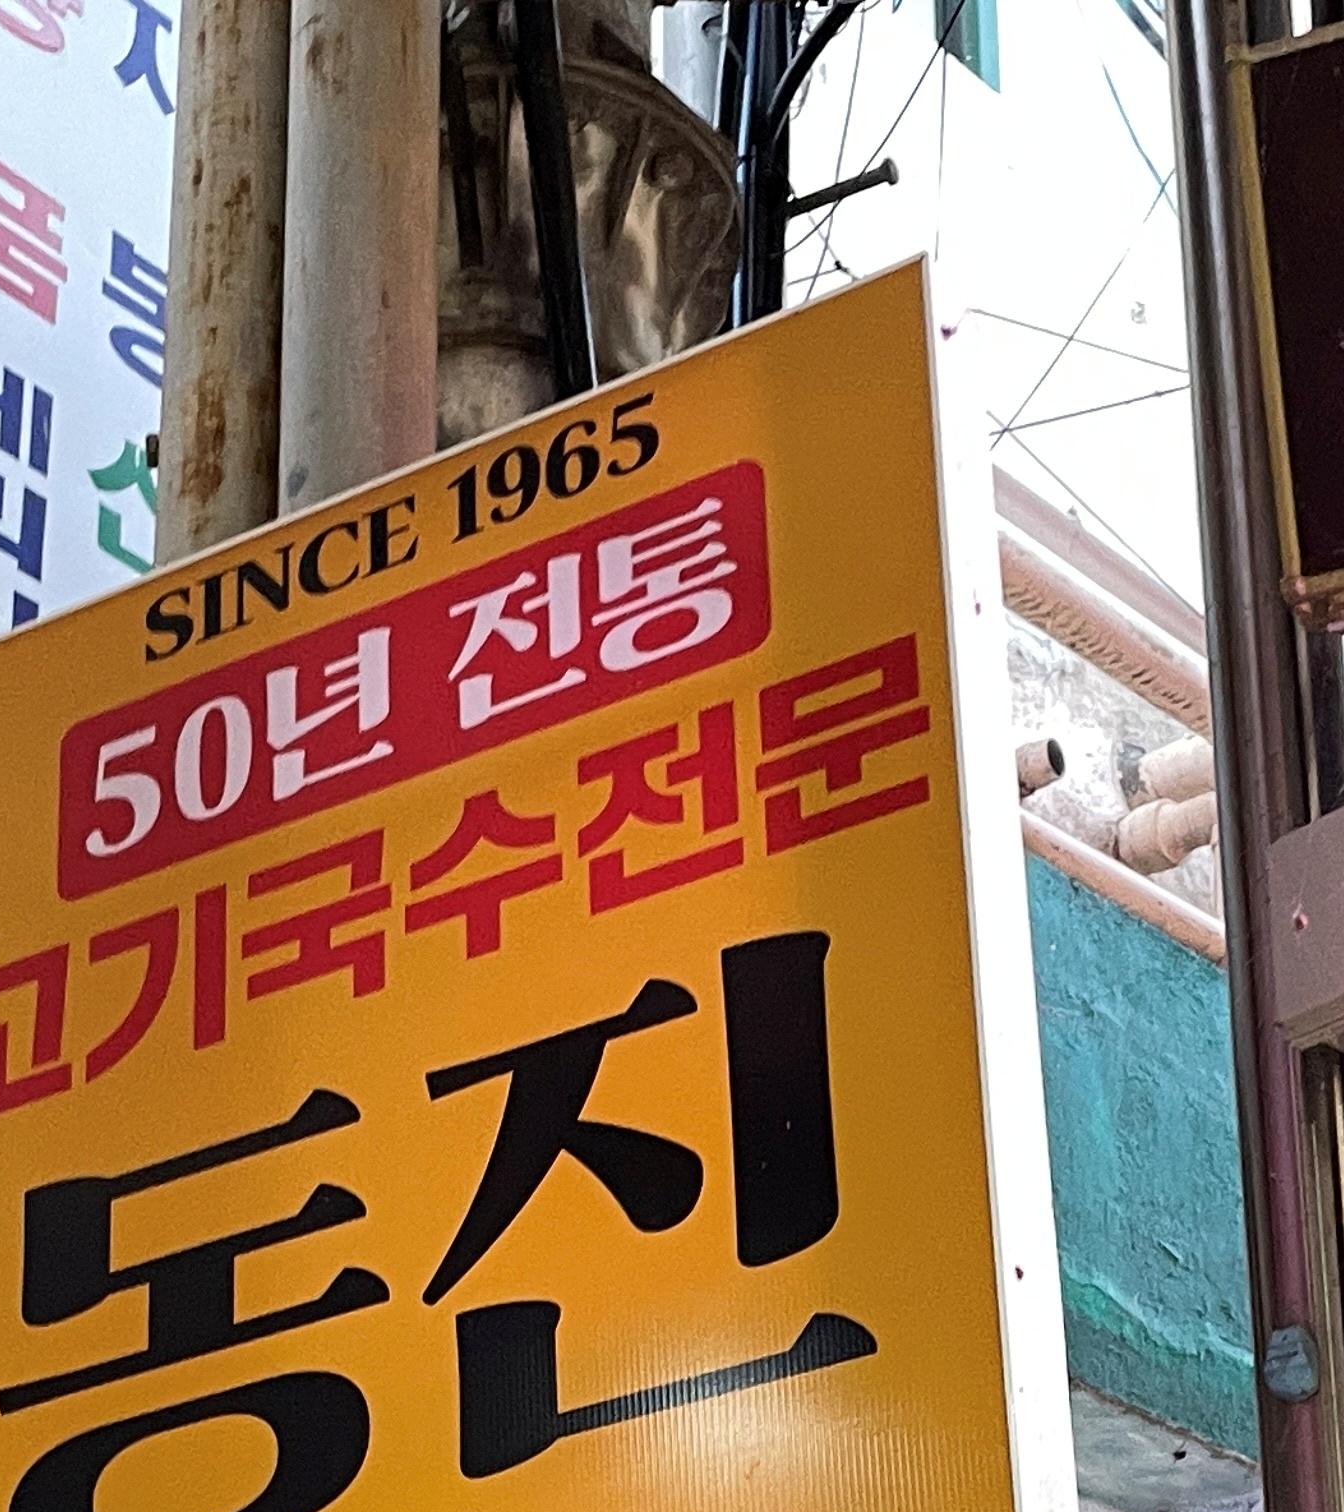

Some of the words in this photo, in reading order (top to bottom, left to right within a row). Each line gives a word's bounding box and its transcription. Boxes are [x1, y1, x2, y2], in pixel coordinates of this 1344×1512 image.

[84, 625, 395, 860] 50년
[446, 496, 739, 731] 전통
[143, 494, 419, 662] SINCE
[447, 393, 661, 544] 1965
